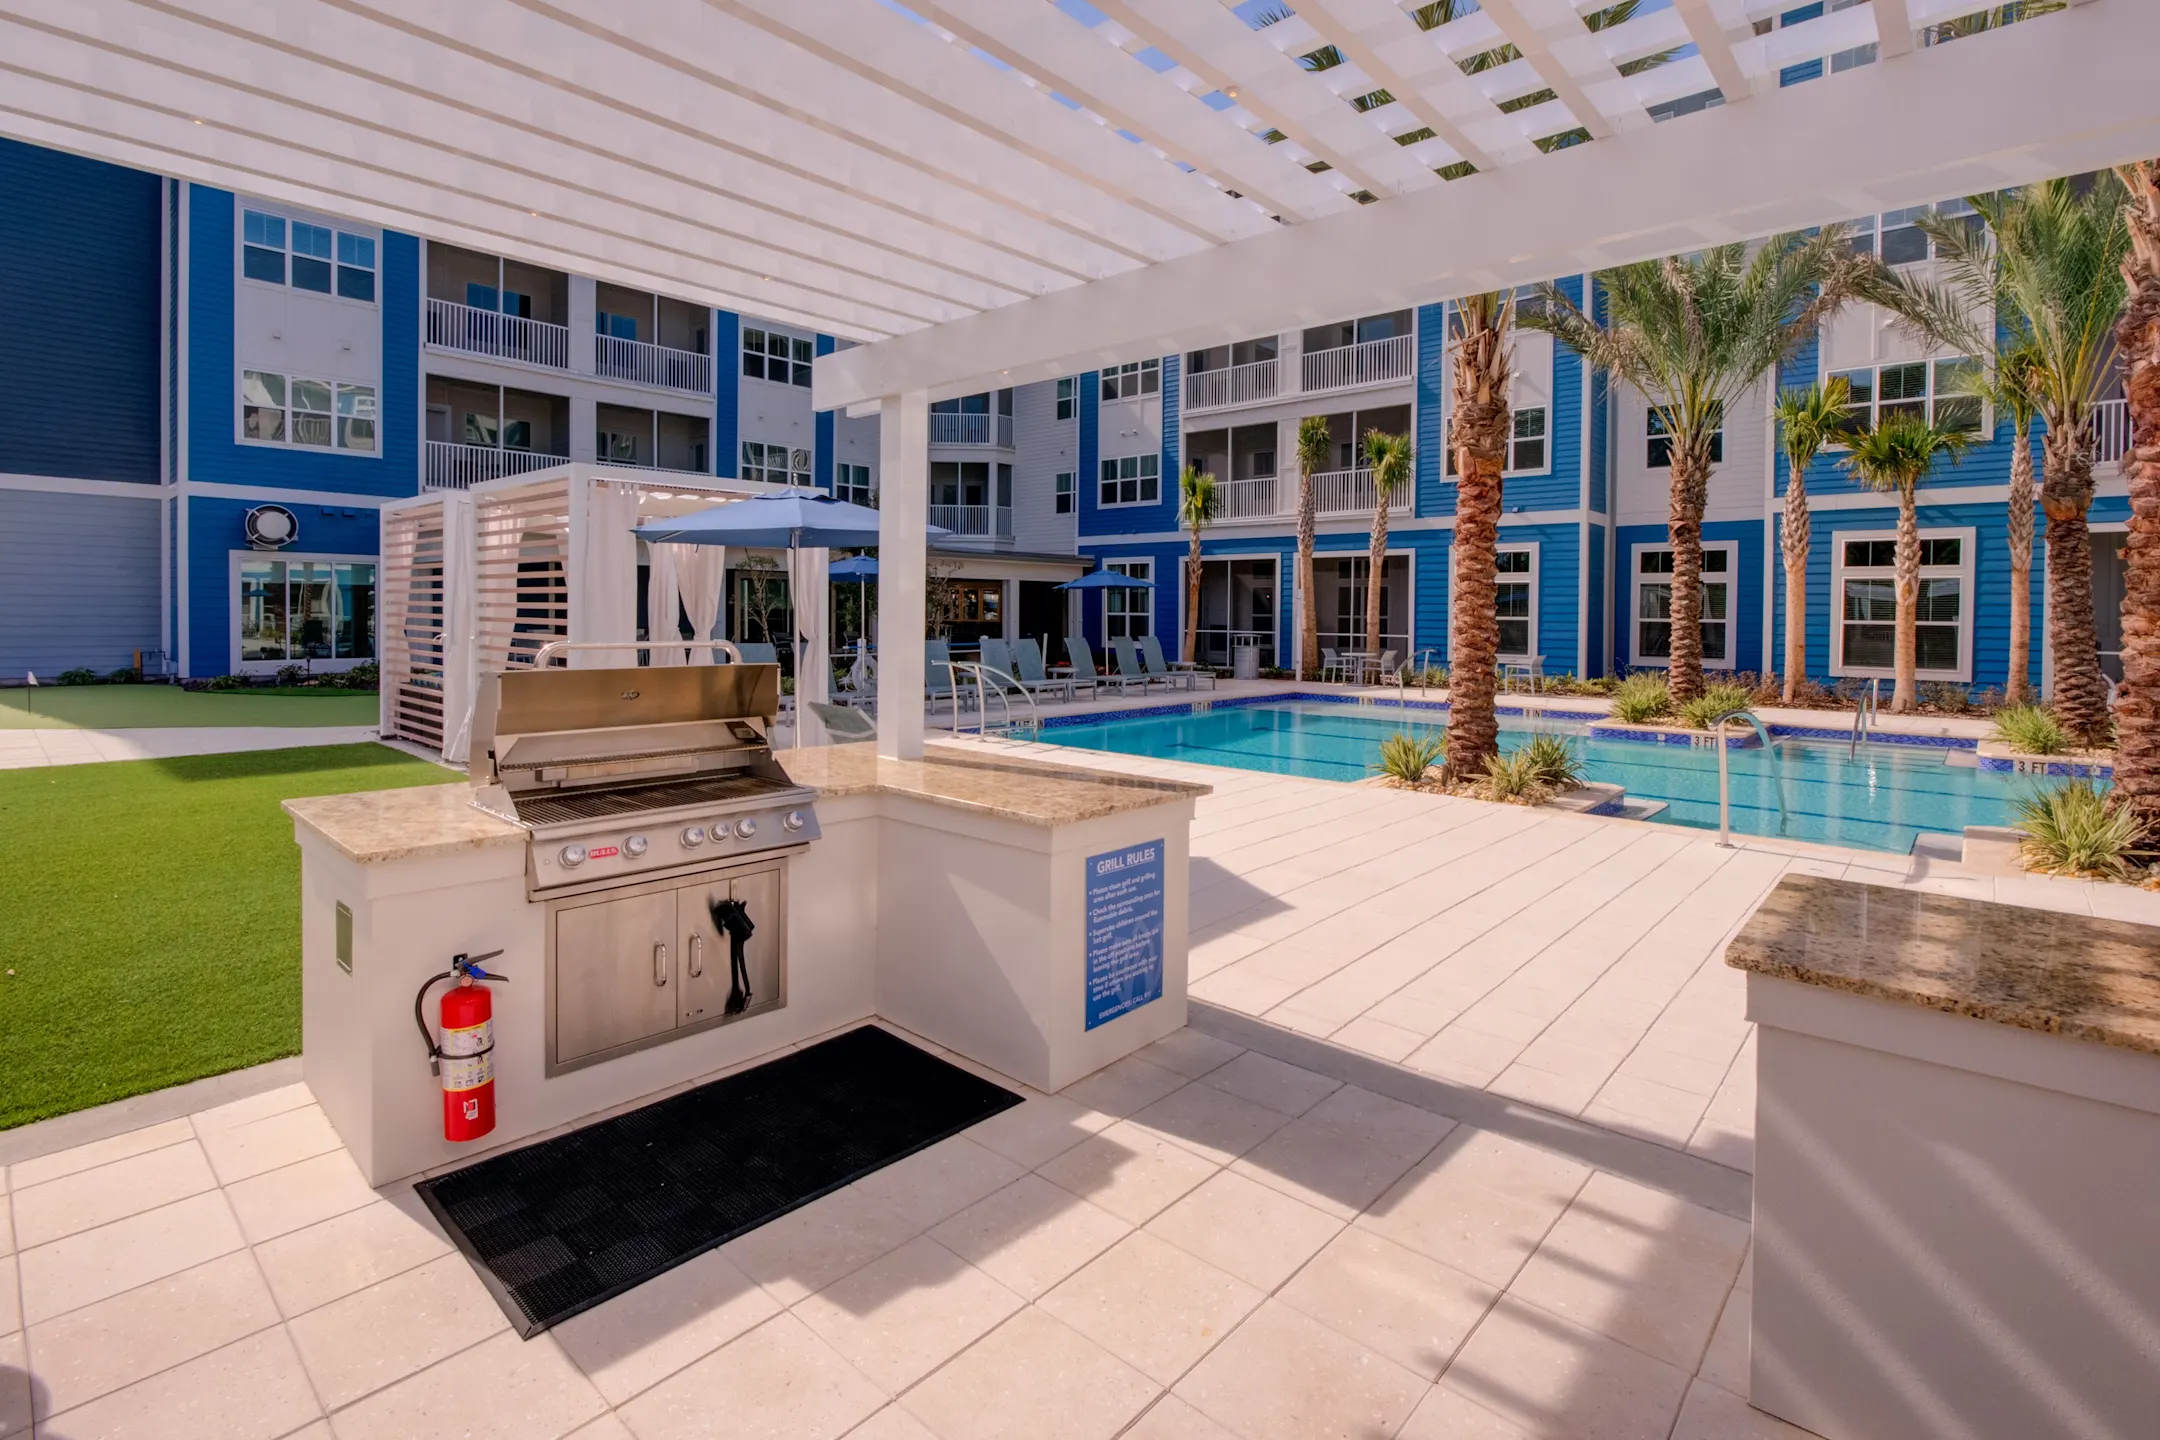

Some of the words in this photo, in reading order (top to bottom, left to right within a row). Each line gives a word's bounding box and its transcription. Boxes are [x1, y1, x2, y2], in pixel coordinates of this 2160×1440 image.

[1533, 709, 1540, 717] IN
[1694, 736, 1700, 747] 3
[1704, 736, 1715, 748] FT
[2018, 760, 2025, 772] 3
[2031, 761, 2047, 775] FT
[1097, 856, 1124, 873] GRILL
[1127, 848, 1155, 865] RULES
[1093, 886, 1108, 895] Please
[1109, 882, 1121, 891] clean
[1122, 878, 1131, 887] grill
[1131, 876, 1140, 884] and
[1140, 872, 1155, 883] grilling
[1105, 891, 1116, 900] after
[1116, 888, 1127, 896] each
[1093, 906, 1107, 915] Check
[1117, 895, 1143, 908] surrounding
[1116, 918, 1134, 928] children
[1135, 911, 1150, 921] around
[1093, 936, 1102, 944] hot
[1093, 947, 1108, 956] Please
[1109, 942, 1121, 951] make
[1122, 938, 1132, 946] sure
[1136, 939, 1150, 948] before
[1093, 962, 1110, 972] leaving
[1119, 954, 1128, 964] grill
[1093, 975, 1108, 985] Please
[1138, 959, 1147, 969] with
[1148, 955, 1158, 966] your
[1093, 984, 1104, 993] time
[1109, 977, 1123, 986] others
[1132, 966, 1148, 976] waiting
[1093, 993, 1102, 1001] use
[1102, 989, 1110, 998] the
[1133, 994, 1144, 1003] CALL
